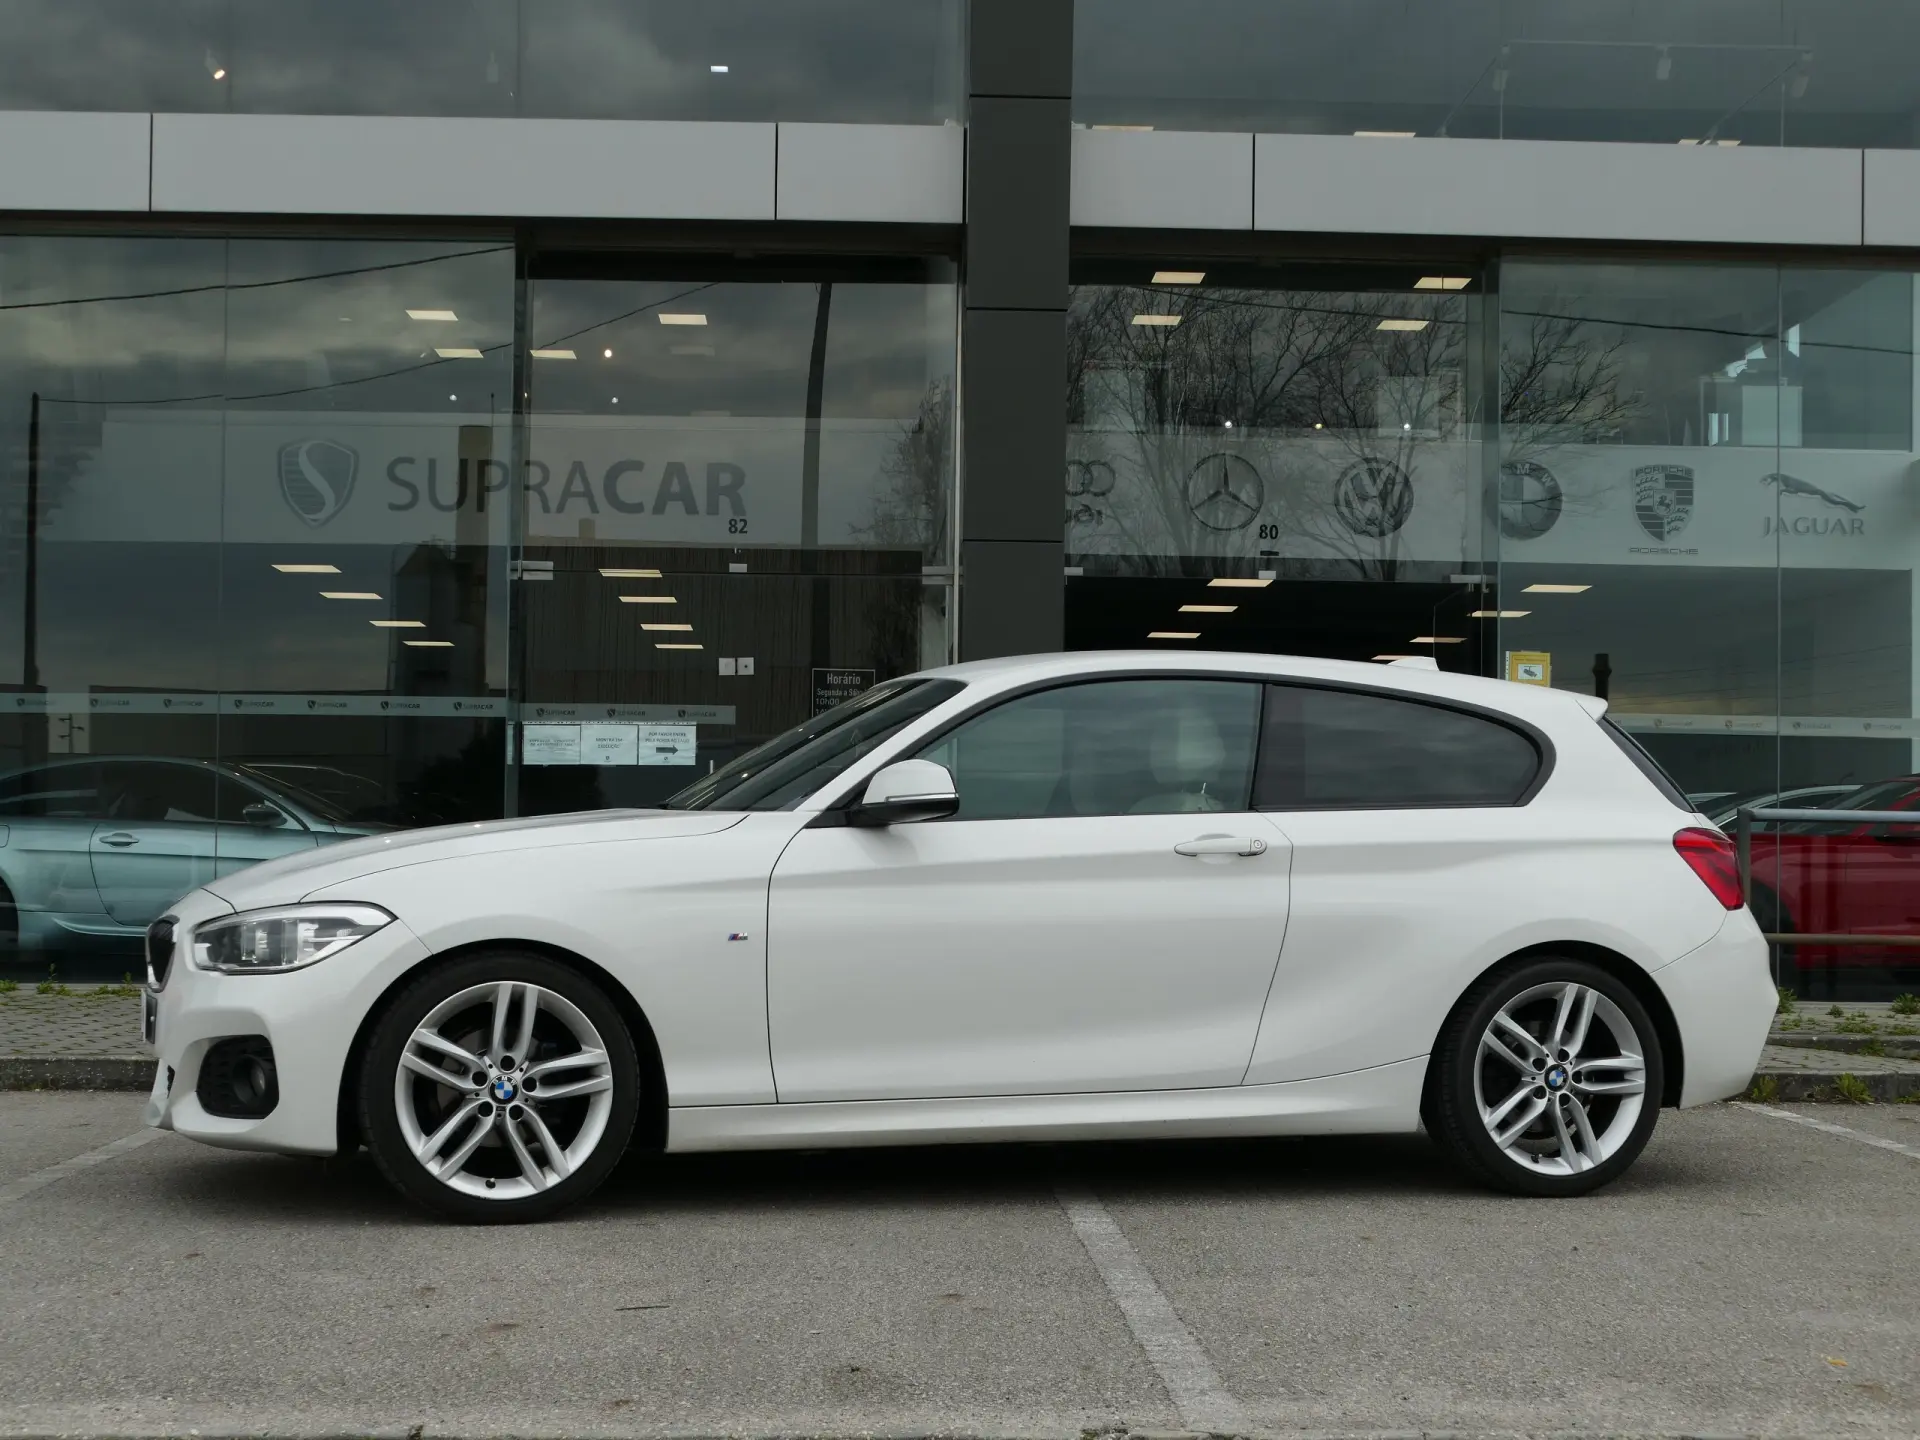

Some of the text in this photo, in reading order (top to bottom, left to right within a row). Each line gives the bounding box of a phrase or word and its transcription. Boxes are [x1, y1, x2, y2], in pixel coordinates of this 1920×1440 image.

[386, 456, 746, 516] SUPRACAR
[728, 518, 748, 535] 82
[1259, 524, 1279, 540] 80
[1763, 516, 1865, 537] JAGUAR
[826, 672, 861, 685] Horário
[816, 687, 842, 697] Segunda
